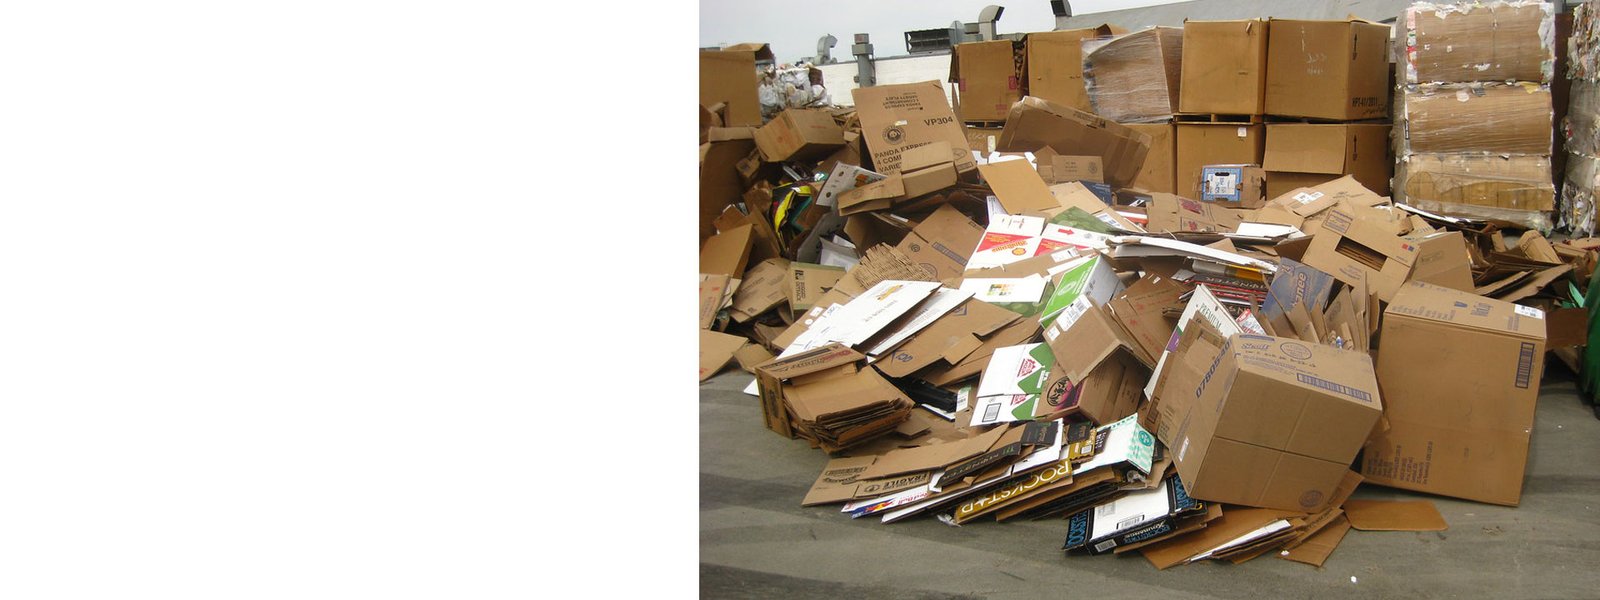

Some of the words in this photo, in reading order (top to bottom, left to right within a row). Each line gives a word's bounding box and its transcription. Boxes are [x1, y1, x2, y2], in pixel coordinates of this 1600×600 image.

[924, 116, 953, 126] VP304
[874, 148, 900, 159] PANDA
[879, 162, 902, 173] VARIE
[886, 473, 927, 486] FRAGILE
